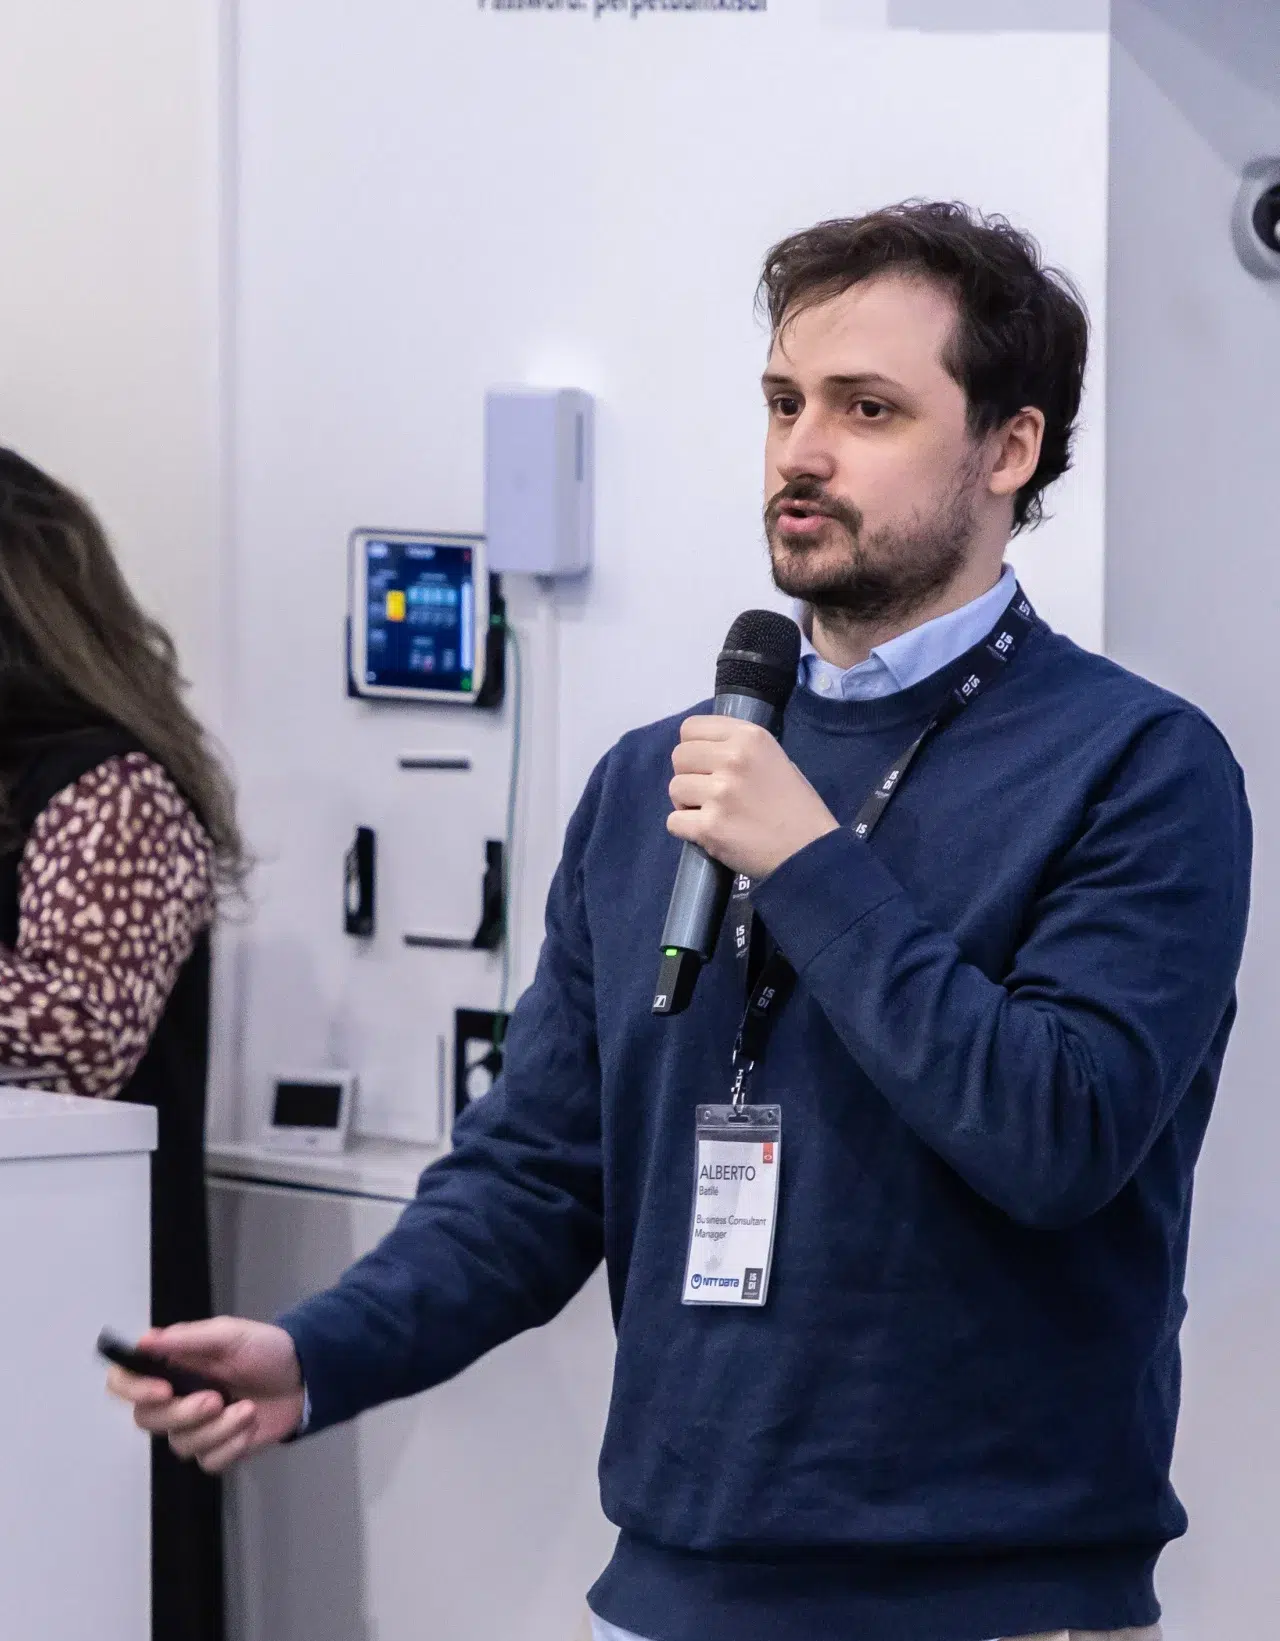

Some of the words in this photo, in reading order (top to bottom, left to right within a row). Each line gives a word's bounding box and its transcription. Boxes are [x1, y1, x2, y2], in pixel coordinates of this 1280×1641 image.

[968, 674, 980, 688] IS
[855, 822, 868, 834] IS
[738, 879, 751, 891] DI
[736, 924, 745, 937] IS
[736, 935, 746, 948] DI
[699, 1164, 756, 1181] ALBERTO
[696, 1213, 727, 1225] Business
[728, 1214, 767, 1226] Consultant
[694, 1228, 727, 1241] Manager
